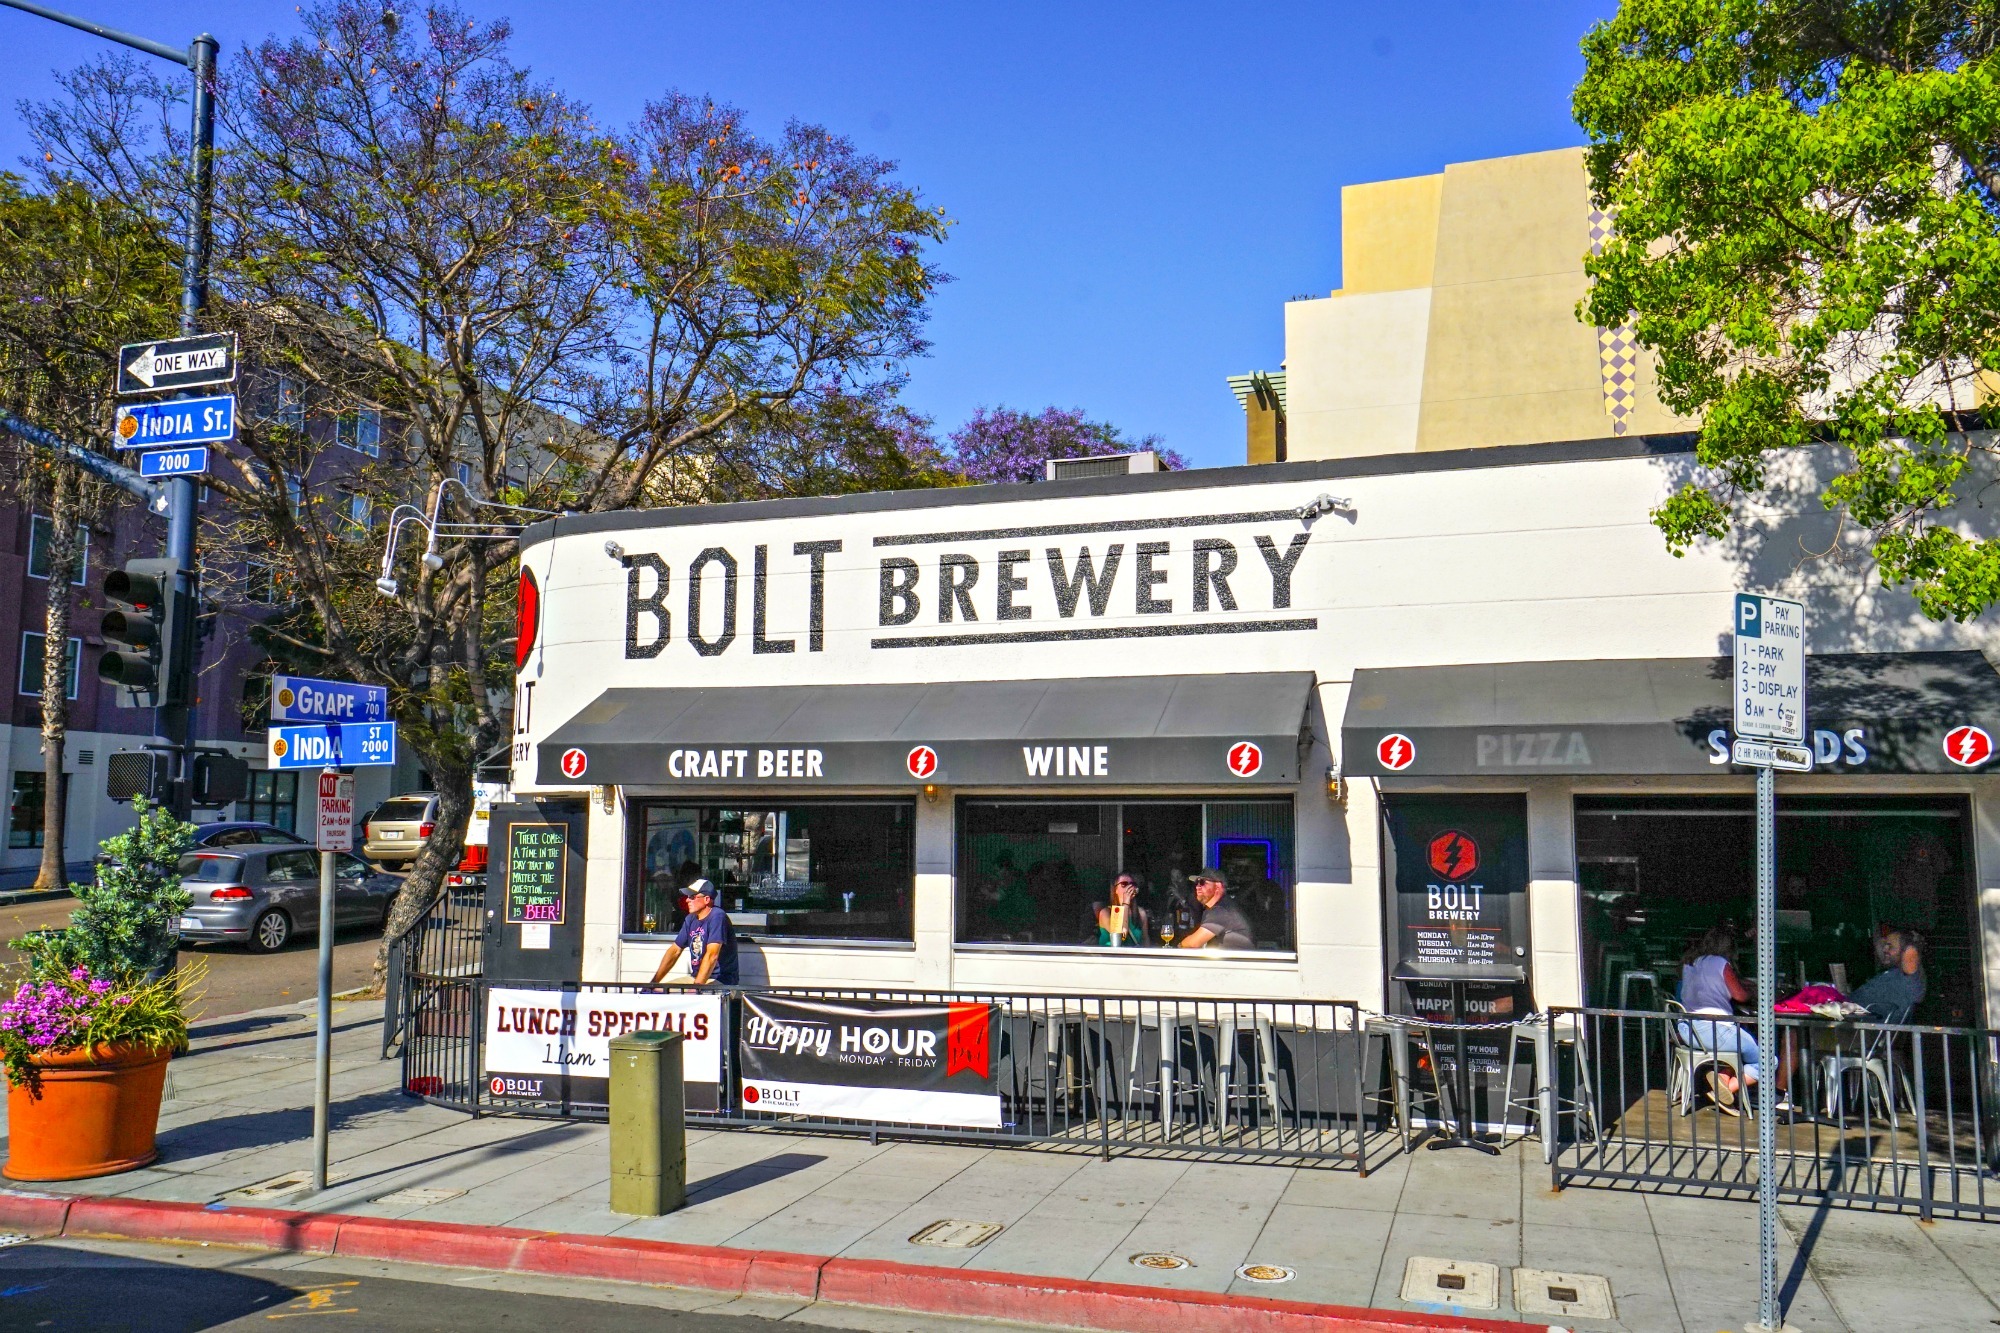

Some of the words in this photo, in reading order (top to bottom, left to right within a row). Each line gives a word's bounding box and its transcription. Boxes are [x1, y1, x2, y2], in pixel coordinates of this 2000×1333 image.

[154, 355, 182, 373] ONE
[188, 351, 217, 369] WAY
[141, 412, 193, 437] INDIA
[203, 407, 228, 432] ST.
[158, 453, 190, 471] 2000
[623, 539, 843, 660] BOLT
[878, 532, 1312, 626] BREWERY
[1741, 601, 1758, 630] P
[1775, 606, 1790, 621] PAY
[1764, 621, 1800, 639] PARKING
[1743, 642, 1747, 656] 1
[1758, 644, 1784, 661] PARK
[1742, 660, 1749, 674] 2
[1758, 663, 1777, 678] PAY
[368, 690, 377, 702] ST
[1742, 679, 1749, 693] 3
[1758, 681, 1798, 699] DISPLAY
[297, 685, 354, 717] GRAPE
[365, 703, 380, 715] 700
[1782, 726, 1796, 736] SECRET
[1785, 720, 1793, 728] TOP
[369, 727, 382, 739] ST
[293, 733, 343, 761] INDIA
[362, 740, 388, 753] 2000
[1476, 731, 1592, 766] PIZZA
[1707, 729, 1867, 765] SDS
[1738, 747, 1742, 758] 2
[1744, 748, 1752, 758] HR
[1753, 749, 1776, 761] PARKING
[668, 749, 748, 778] CRAFT
[757, 749, 824, 778] BEER
[1023, 746, 1108, 777] WINE
[322, 778, 333, 794] NO
[322, 799, 351, 813] PARKING
[516, 829, 539, 844] THERE
[542, 833, 563, 844] COMES
[513, 847, 520, 858] A
[540, 847, 546, 857] IN
[547, 848, 559, 858] THE
[513, 860, 526, 870] DAY
[527, 861, 544, 870] THAT
[546, 861, 554, 870] NO
[512, 872, 537, 883] MATTER
[540, 874, 555, 883] THE
[513, 896, 526, 904] THE
[1427, 885, 1483, 910] BOLT
[513, 908, 521, 917] IS
[524, 900, 560, 920] BEER!
[1429, 911, 1480, 920] BREWERY
[497, 1006, 577, 1036] LUNCH
[588, 1010, 709, 1040] SPECIALS
[747, 1016, 832, 1057] Hoppy
[840, 1025, 936, 1057] HOUR
[542, 1043, 595, 1066] 11am
[1434, 1043, 1455, 1051] NIGHT
[1479, 1046, 1499, 1054] HOUR
[839, 1054, 886, 1065] MONDAY
[898, 1057, 937, 1068] FRIDAY
[506, 1079, 543, 1091] BOLT
[761, 1088, 800, 1101] BOLT
